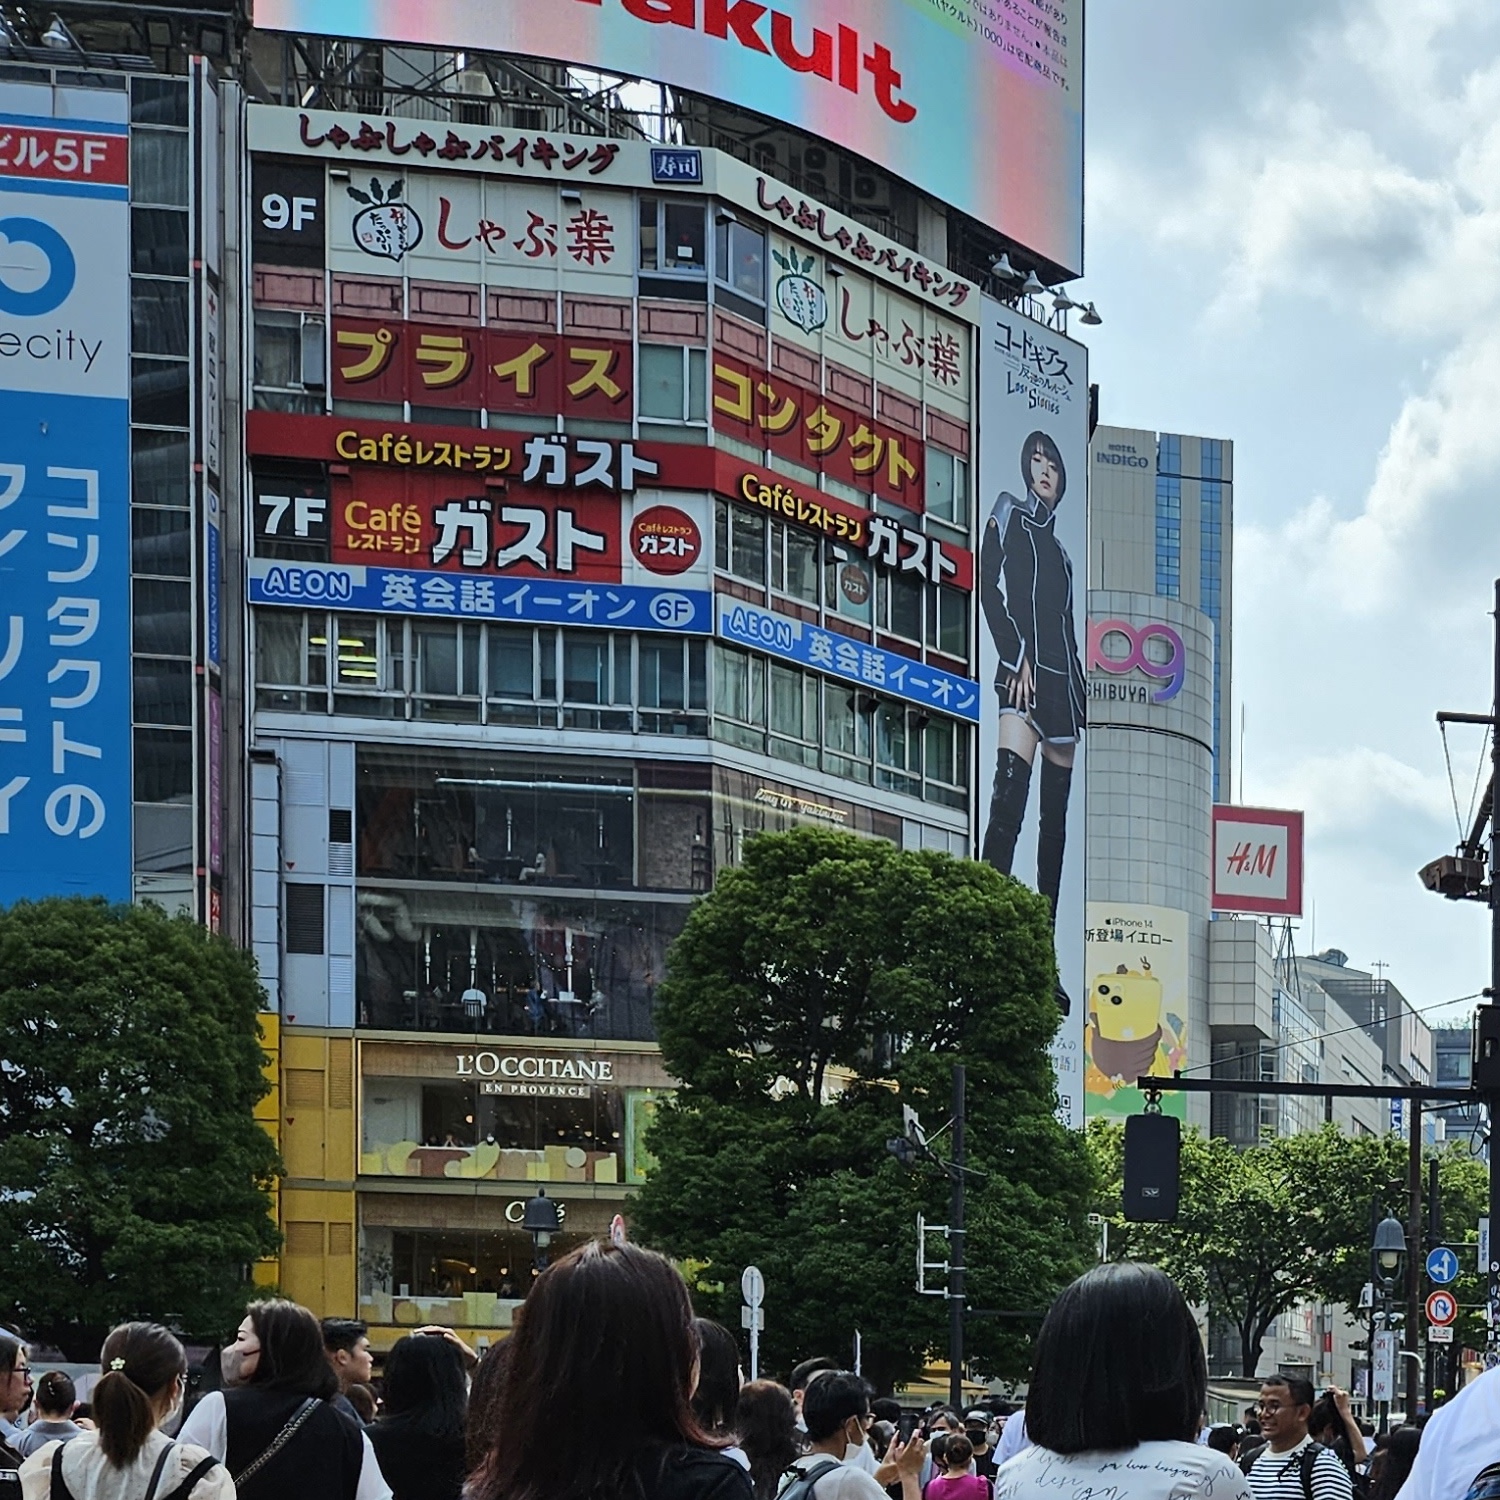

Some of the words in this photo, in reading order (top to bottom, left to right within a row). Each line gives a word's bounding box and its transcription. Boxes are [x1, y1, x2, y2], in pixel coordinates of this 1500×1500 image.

[610, 0, 916, 123] akult
[298, 112, 620, 175] しゃぶしゃぶバイキング
[656, 153, 698, 178] 寿司
[261, 194, 317, 232] 9F
[438, 197, 616, 267] しゃぶ葉
[756, 175, 972, 307] しゃぶしゃぶバイキング
[840, 286, 962, 387] しゃぶ葉
[994, 321, 1075, 386] コードギアス
[336, 326, 624, 402] プライス
[713, 361, 919, 489] コンタクト
[334, 428, 513, 473] Caféレストラン
[521, 433, 661, 490] ガスト
[1096, 452, 1149, 469] INDIGO
[1108, 443, 1137, 453] HOTEL
[258, 494, 328, 538] 7F
[344, 499, 422, 534] Café
[432, 498, 605, 572] ガスト
[347, 533, 421, 555] レストラン
[639, 535, 695, 556] ガスト
[867, 516, 957, 585] ガスト
[261, 566, 353, 601] AEON
[380, 573, 637, 619] 英会話イーオン
[655, 598, 690, 621] 6F
[728, 606, 795, 652] AEON
[44, 465, 106, 840] コンタクトの
[807, 630, 977, 710] 英会話イーオン
[1087, 681, 1148, 703] SHIBUYA
[1226, 841, 1278, 879] H&M
[1112, 917, 1143, 928] iPhone
[1144, 919, 1154, 929] 14
[456, 1051, 614, 1082] L'OCCITANE
[484, 1083, 503, 1095] EN
[510, 1084, 587, 1098] PROVENCE
[504, 1200, 566, 1225] Cé
